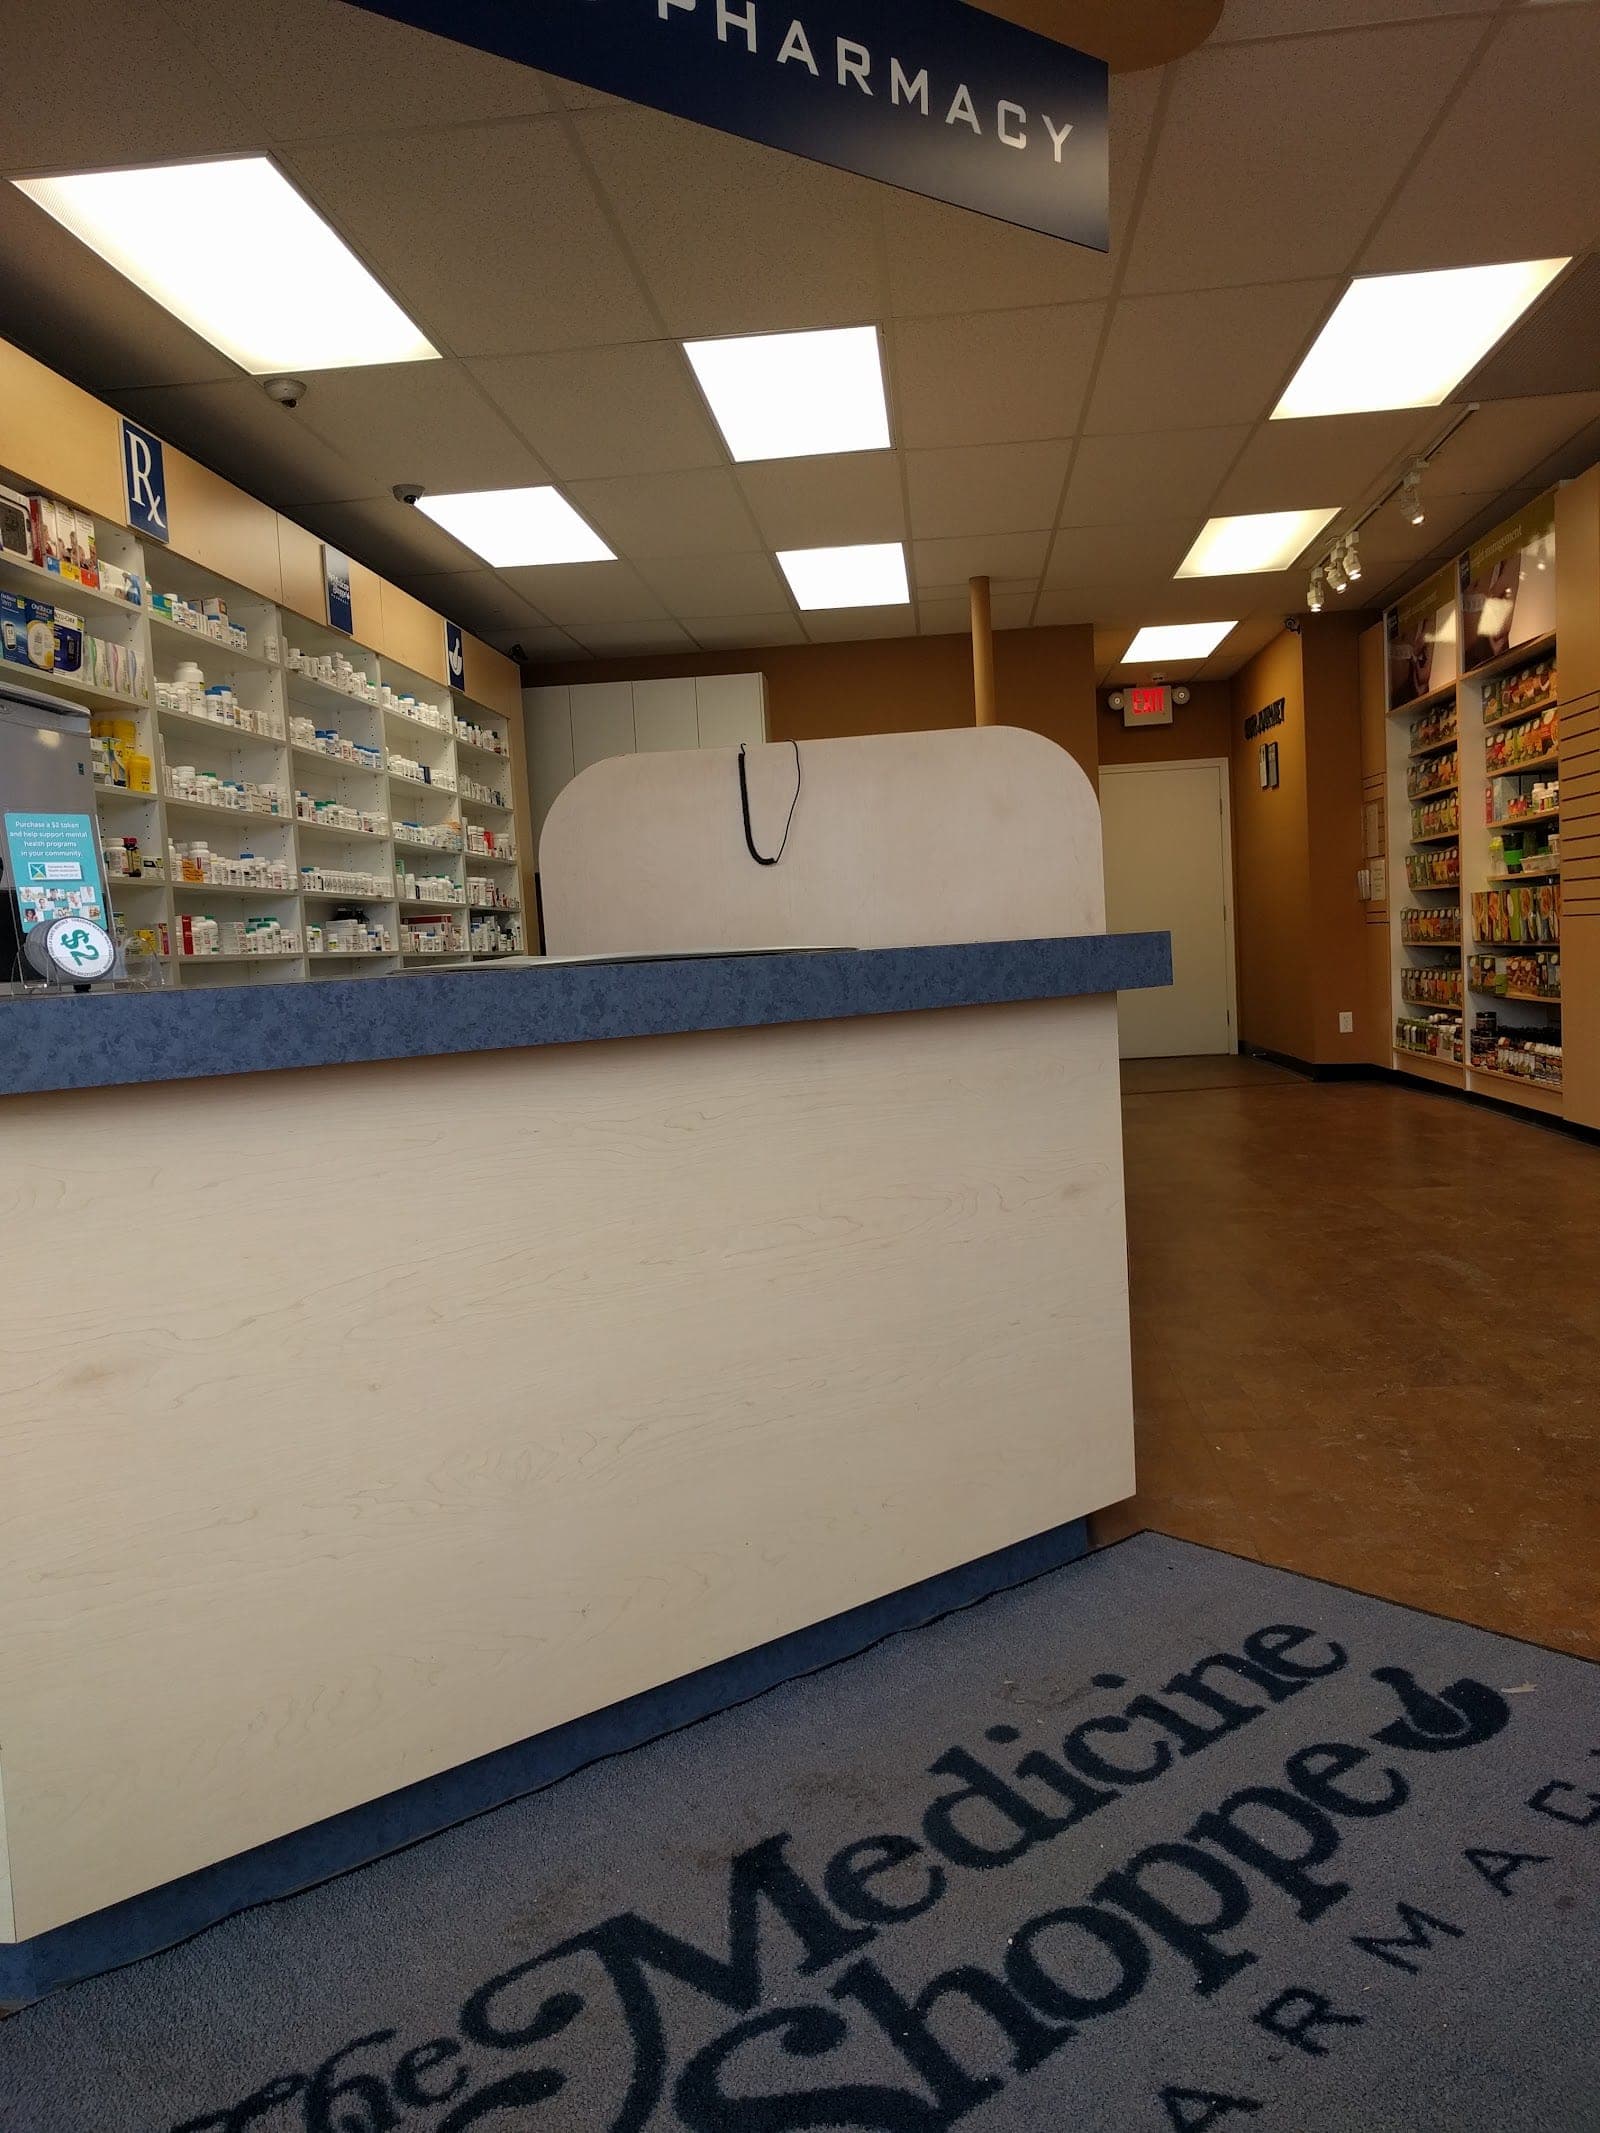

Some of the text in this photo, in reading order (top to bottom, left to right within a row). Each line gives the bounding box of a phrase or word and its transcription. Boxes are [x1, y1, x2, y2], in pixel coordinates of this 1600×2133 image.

[1132, 688, 1164, 714] EXIT
[51, 821, 59, 829] $2
[60, 929, 99, 966] $2
[438, 1624, 1348, 2133] Medicine
[672, 1742, 1410, 2133] Shoppe
